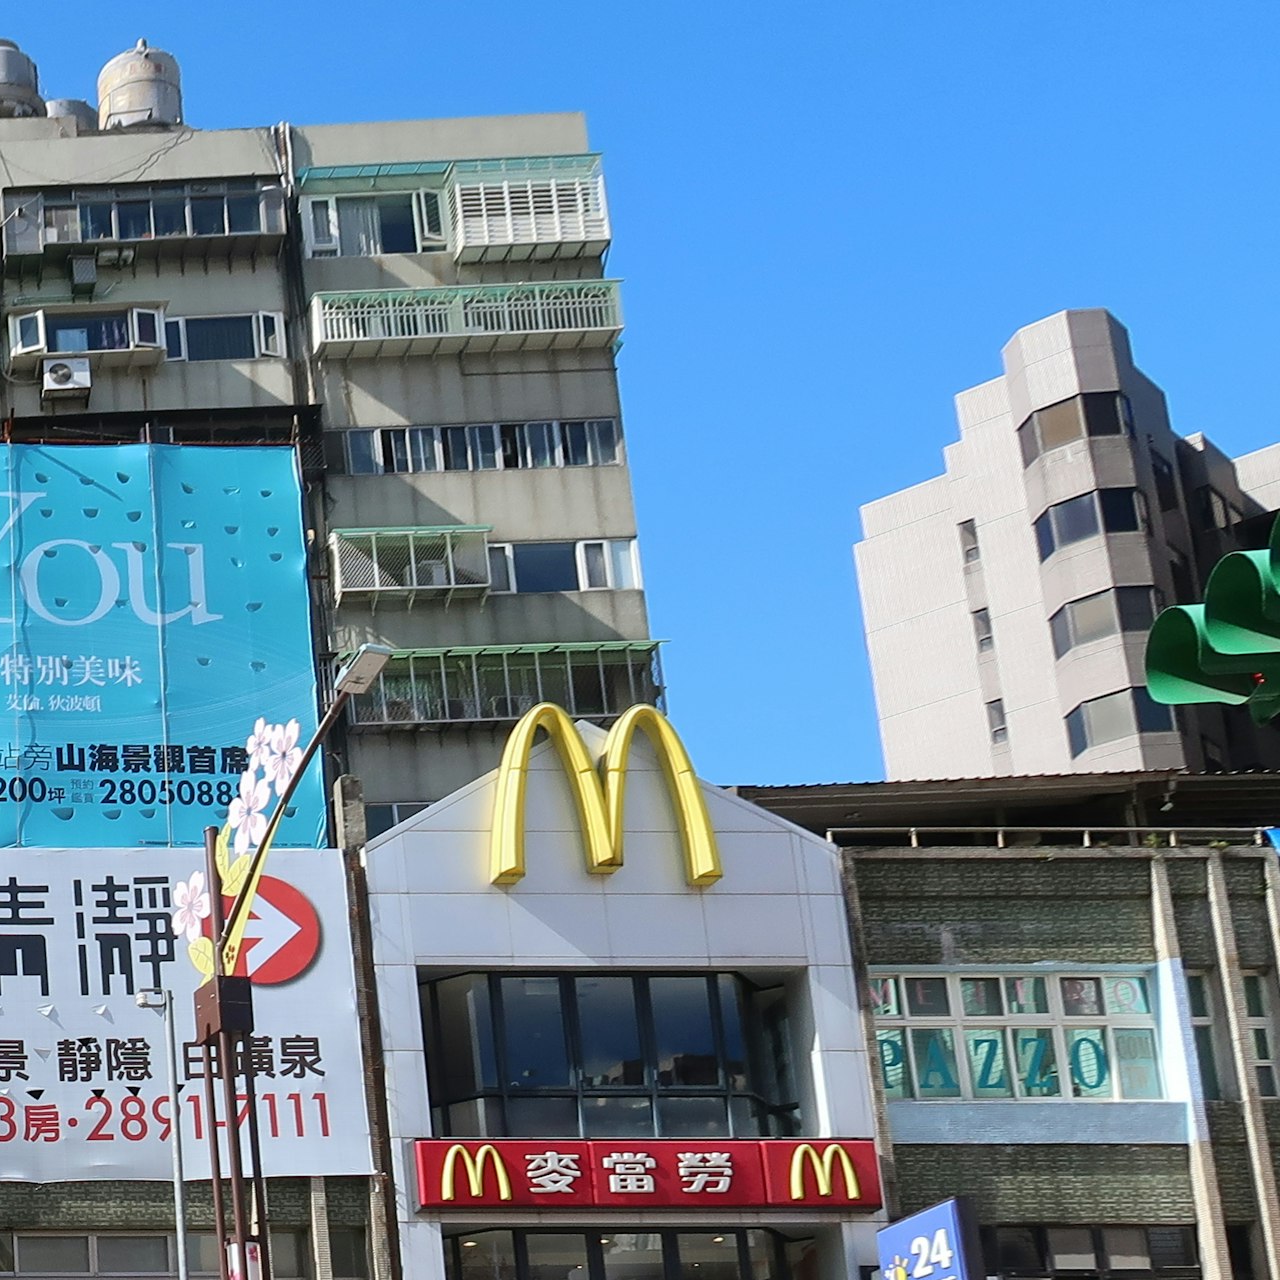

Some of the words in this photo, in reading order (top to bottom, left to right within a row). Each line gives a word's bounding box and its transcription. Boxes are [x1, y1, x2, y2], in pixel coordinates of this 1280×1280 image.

[880, 1037, 1110, 1090] PAZZO
[525, 1151, 733, 1195] 麥當勞
[909, 1228, 954, 1278] 24
